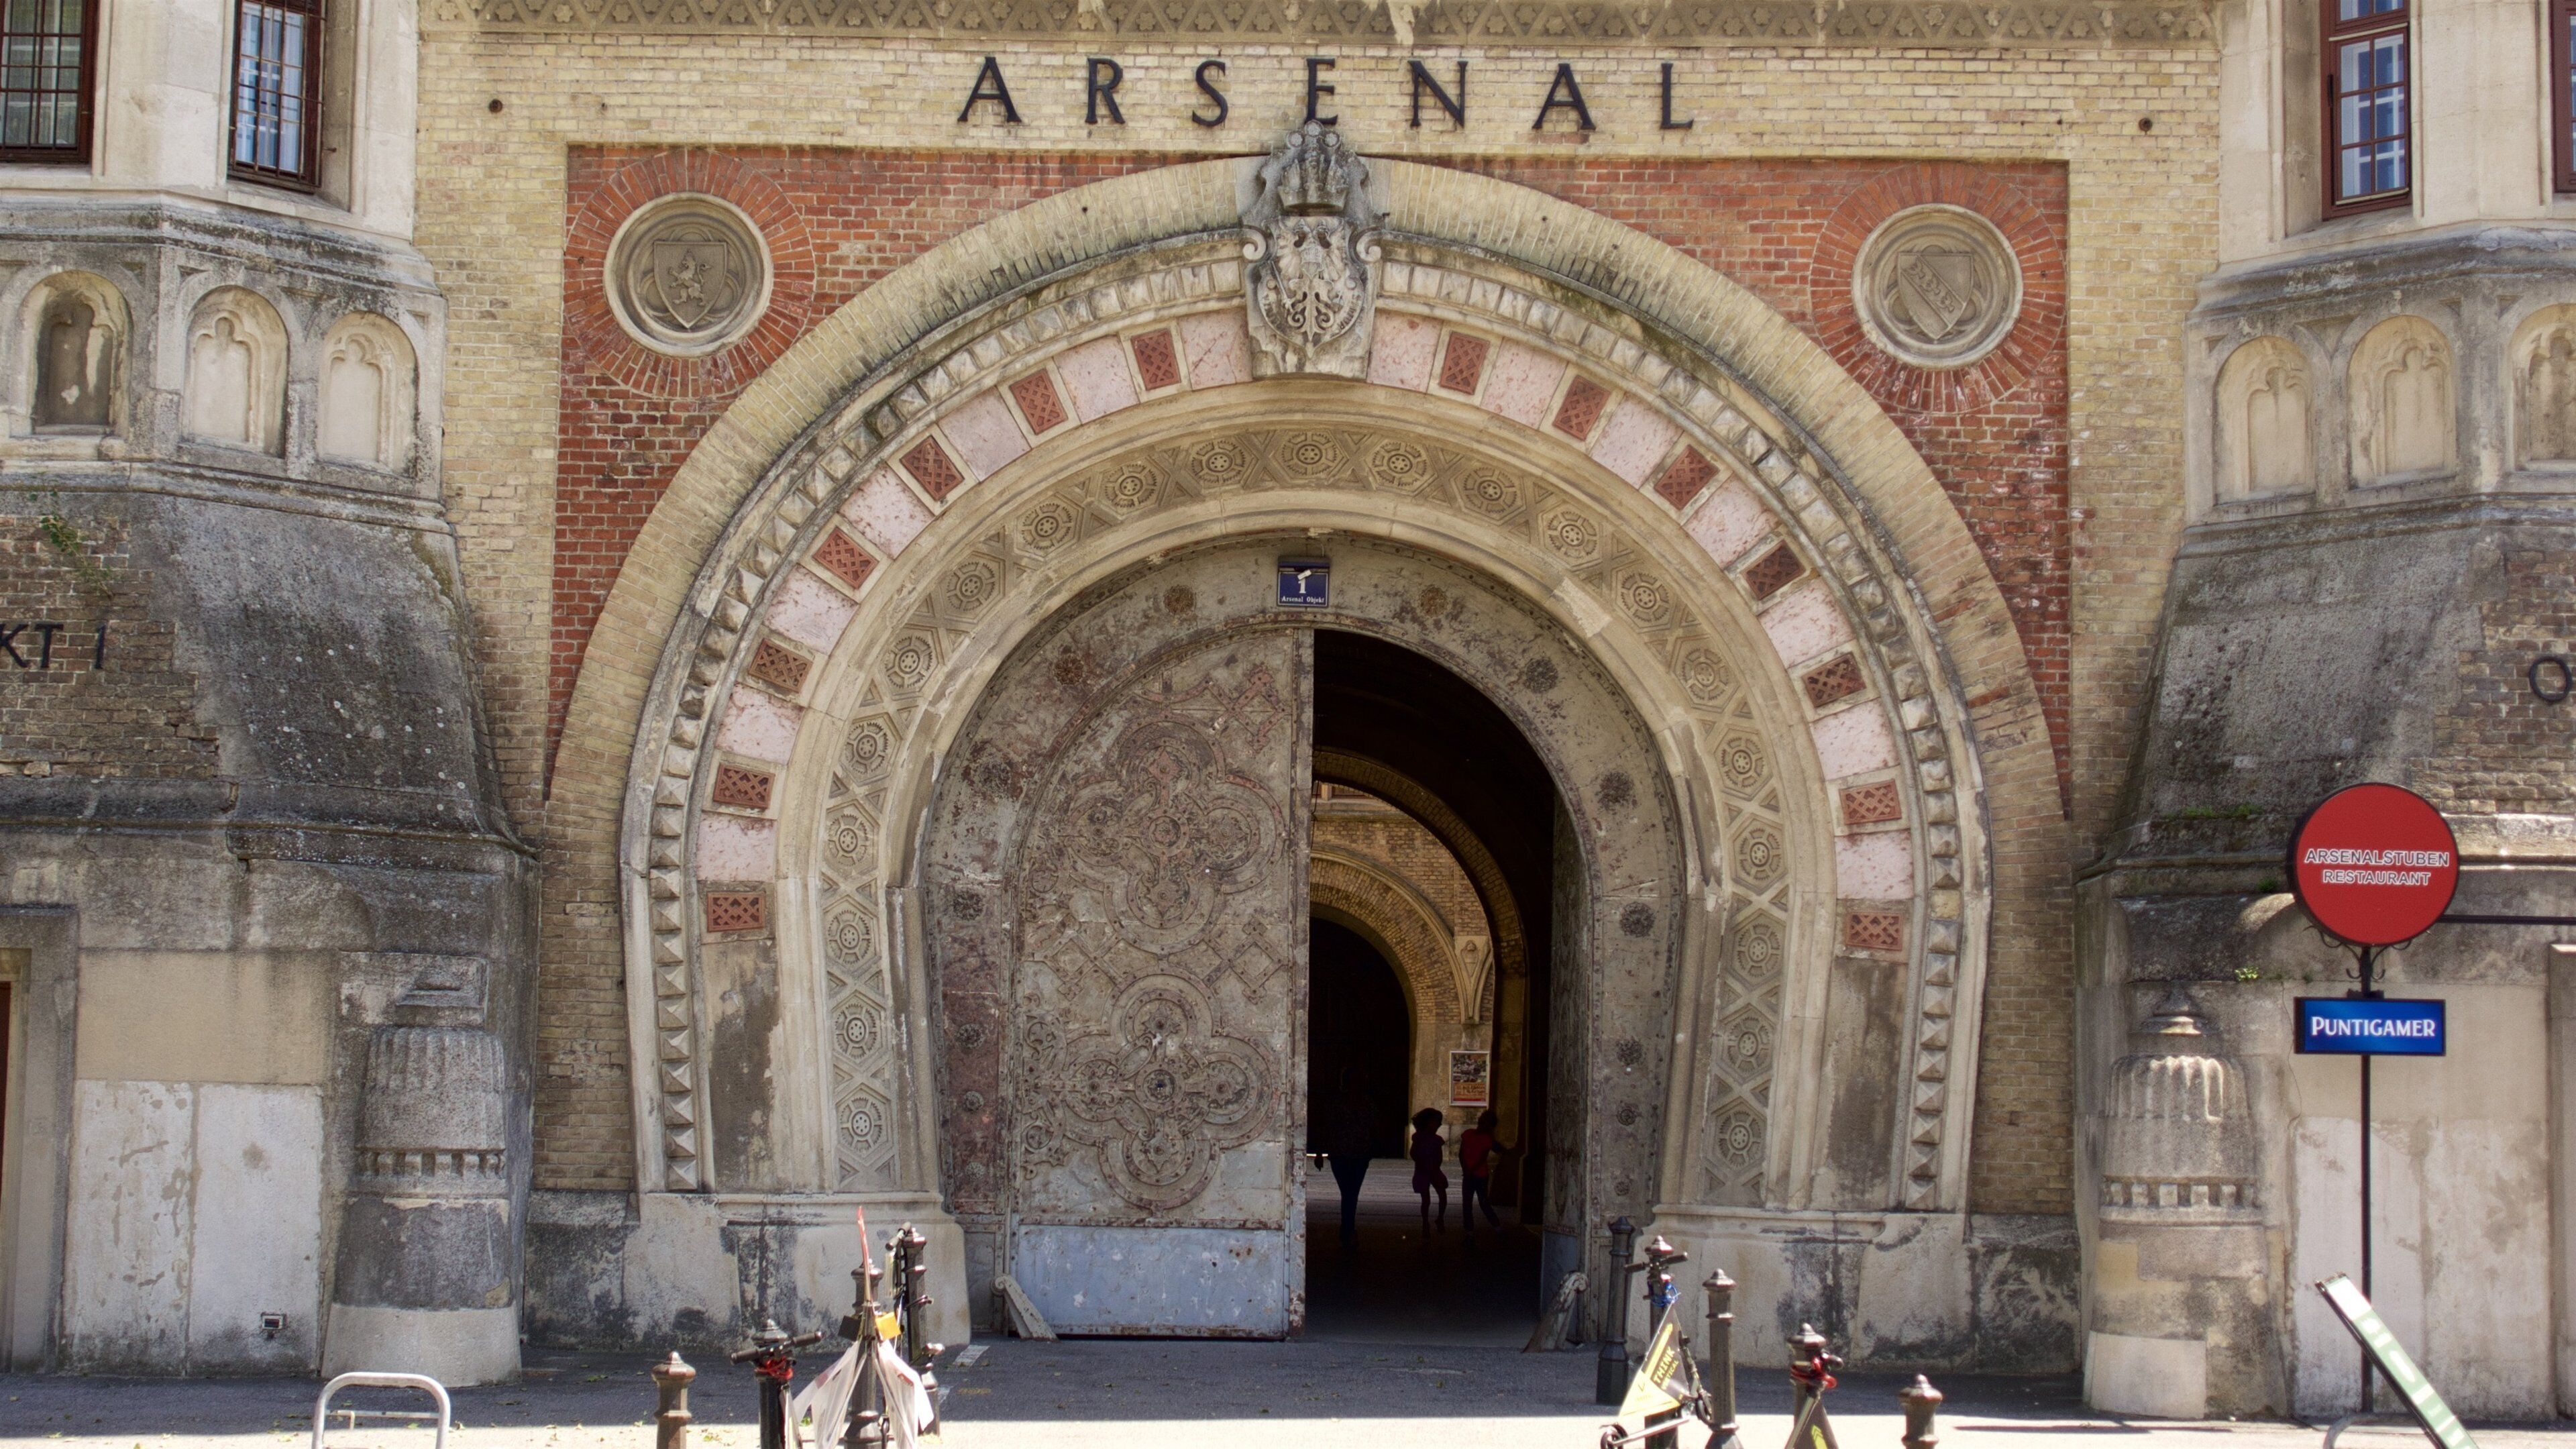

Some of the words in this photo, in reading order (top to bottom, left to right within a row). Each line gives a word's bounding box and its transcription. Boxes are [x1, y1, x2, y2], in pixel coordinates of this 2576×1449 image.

[957, 56, 1694, 131] ARSENAL
[1306, 596, 1325, 604] Objekt
[2304, 849, 2449, 866] ARSENALSTUBEN
[2322, 870, 2431, 885] RESTAURANT
[1653, 1346, 1675, 1383] THINK
